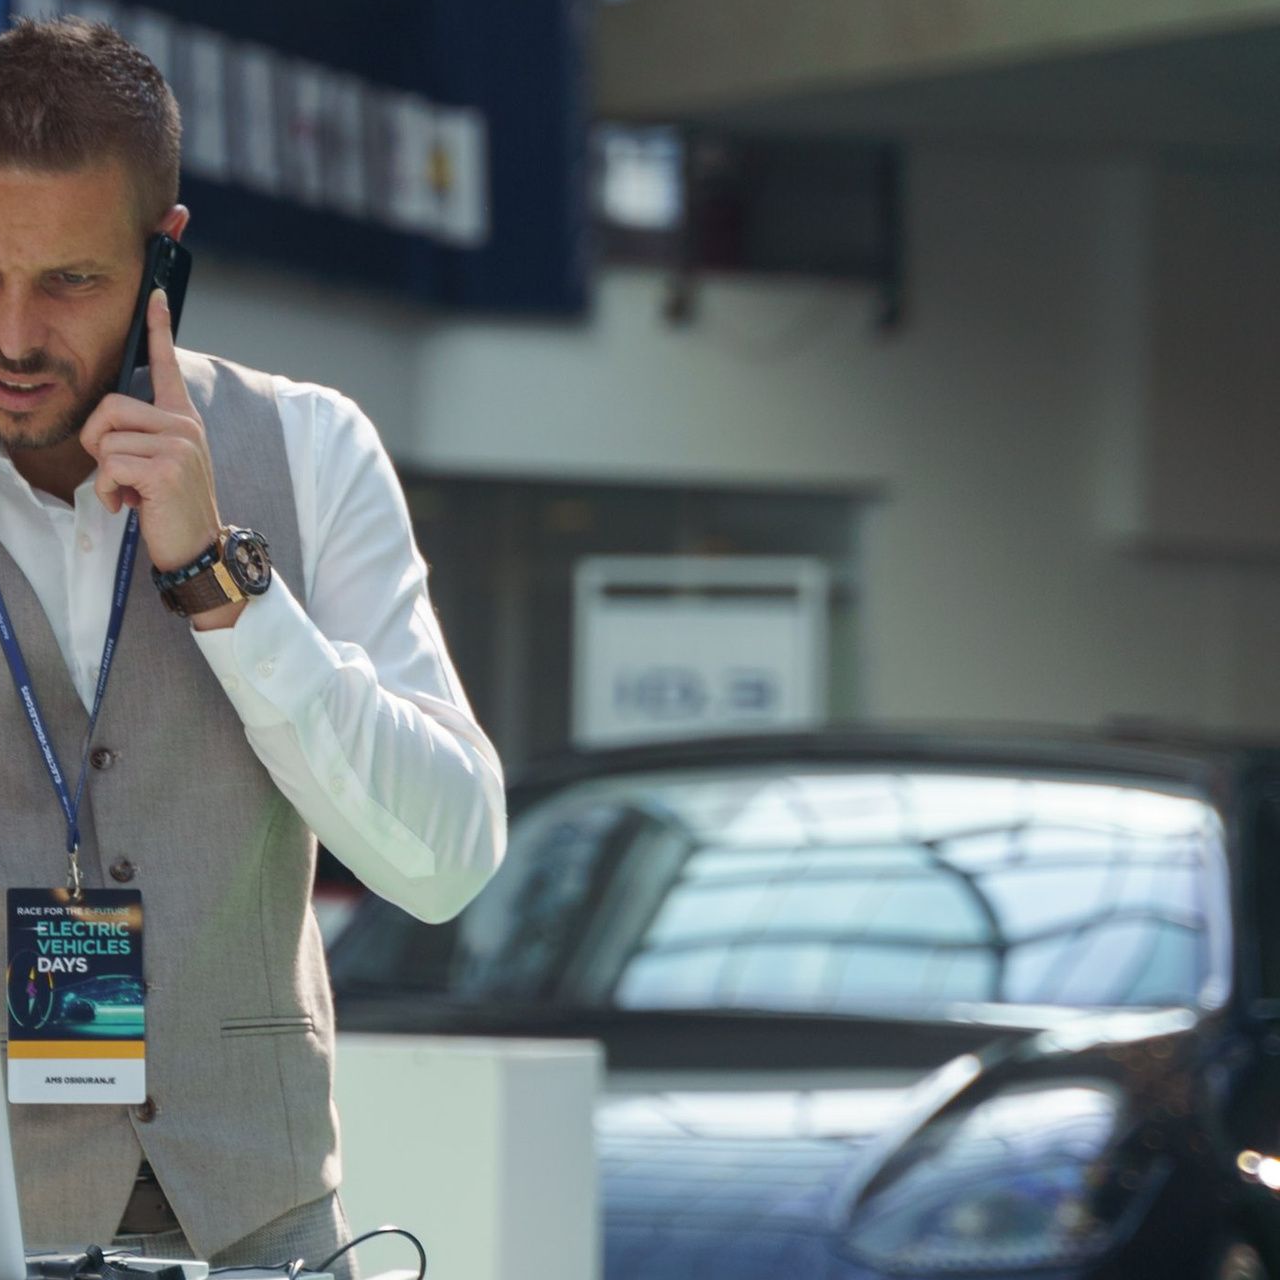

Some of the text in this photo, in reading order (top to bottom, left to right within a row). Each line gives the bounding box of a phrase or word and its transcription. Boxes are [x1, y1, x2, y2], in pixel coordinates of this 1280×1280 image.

[21, 685, 62, 784] ELECTRIC VEHICLES DAYS
[17, 907, 130, 915] RACE FOR THE E-FUTURE
[37, 921, 130, 936] ELECTRIC
[37, 939, 131, 954] VEHICLES
[37, 957, 88, 973] DAYS
